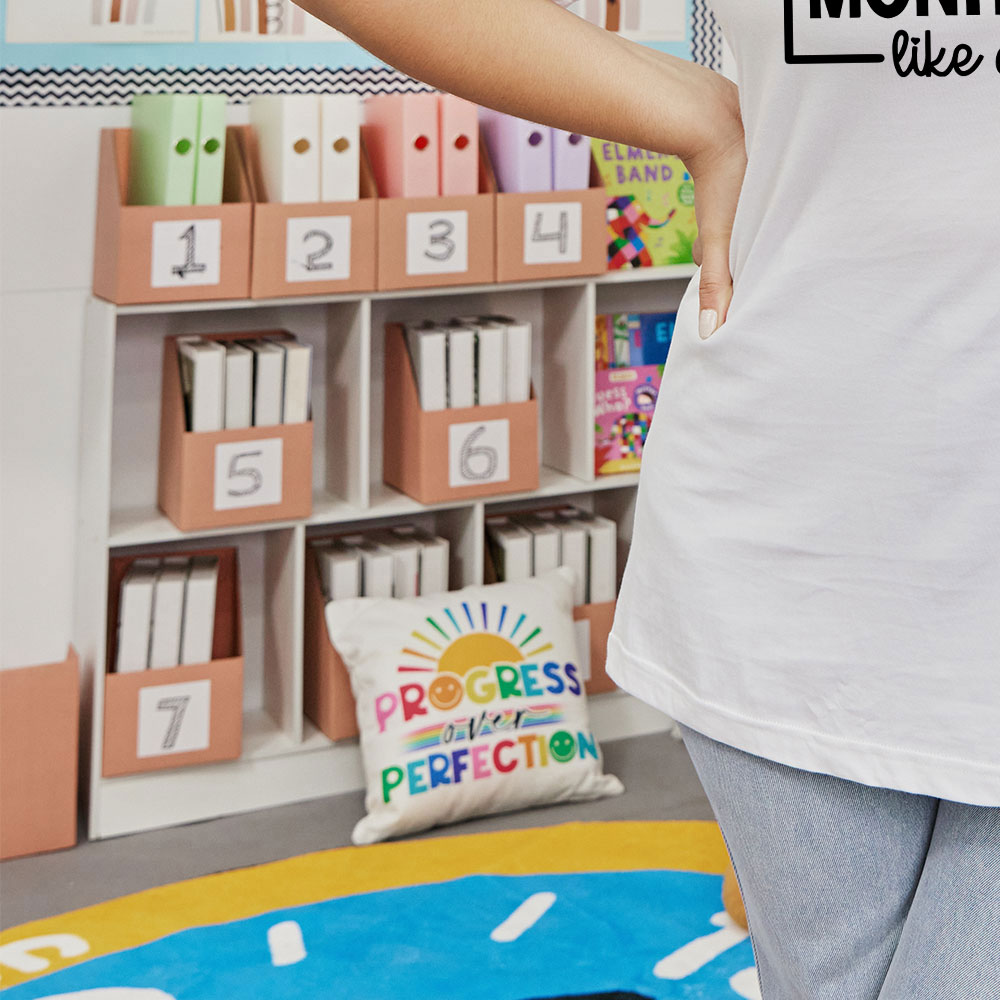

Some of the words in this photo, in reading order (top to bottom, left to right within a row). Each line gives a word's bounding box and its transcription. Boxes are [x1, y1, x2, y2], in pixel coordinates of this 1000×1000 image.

[892, 28, 984, 78] like
[616, 164, 673, 184] BAND
[172, 224, 207, 279] 1
[303, 229, 334, 272] 2
[424, 218, 456, 262] 3
[531, 210, 569, 255] 4
[227, 450, 263, 497] 5
[459, 425, 499, 482] 6
[375, 661, 582, 734] PROGRESS
[156, 695, 191, 750] 7
[443, 708, 528, 744] over
[381, 729, 599, 804] PERFECTION
